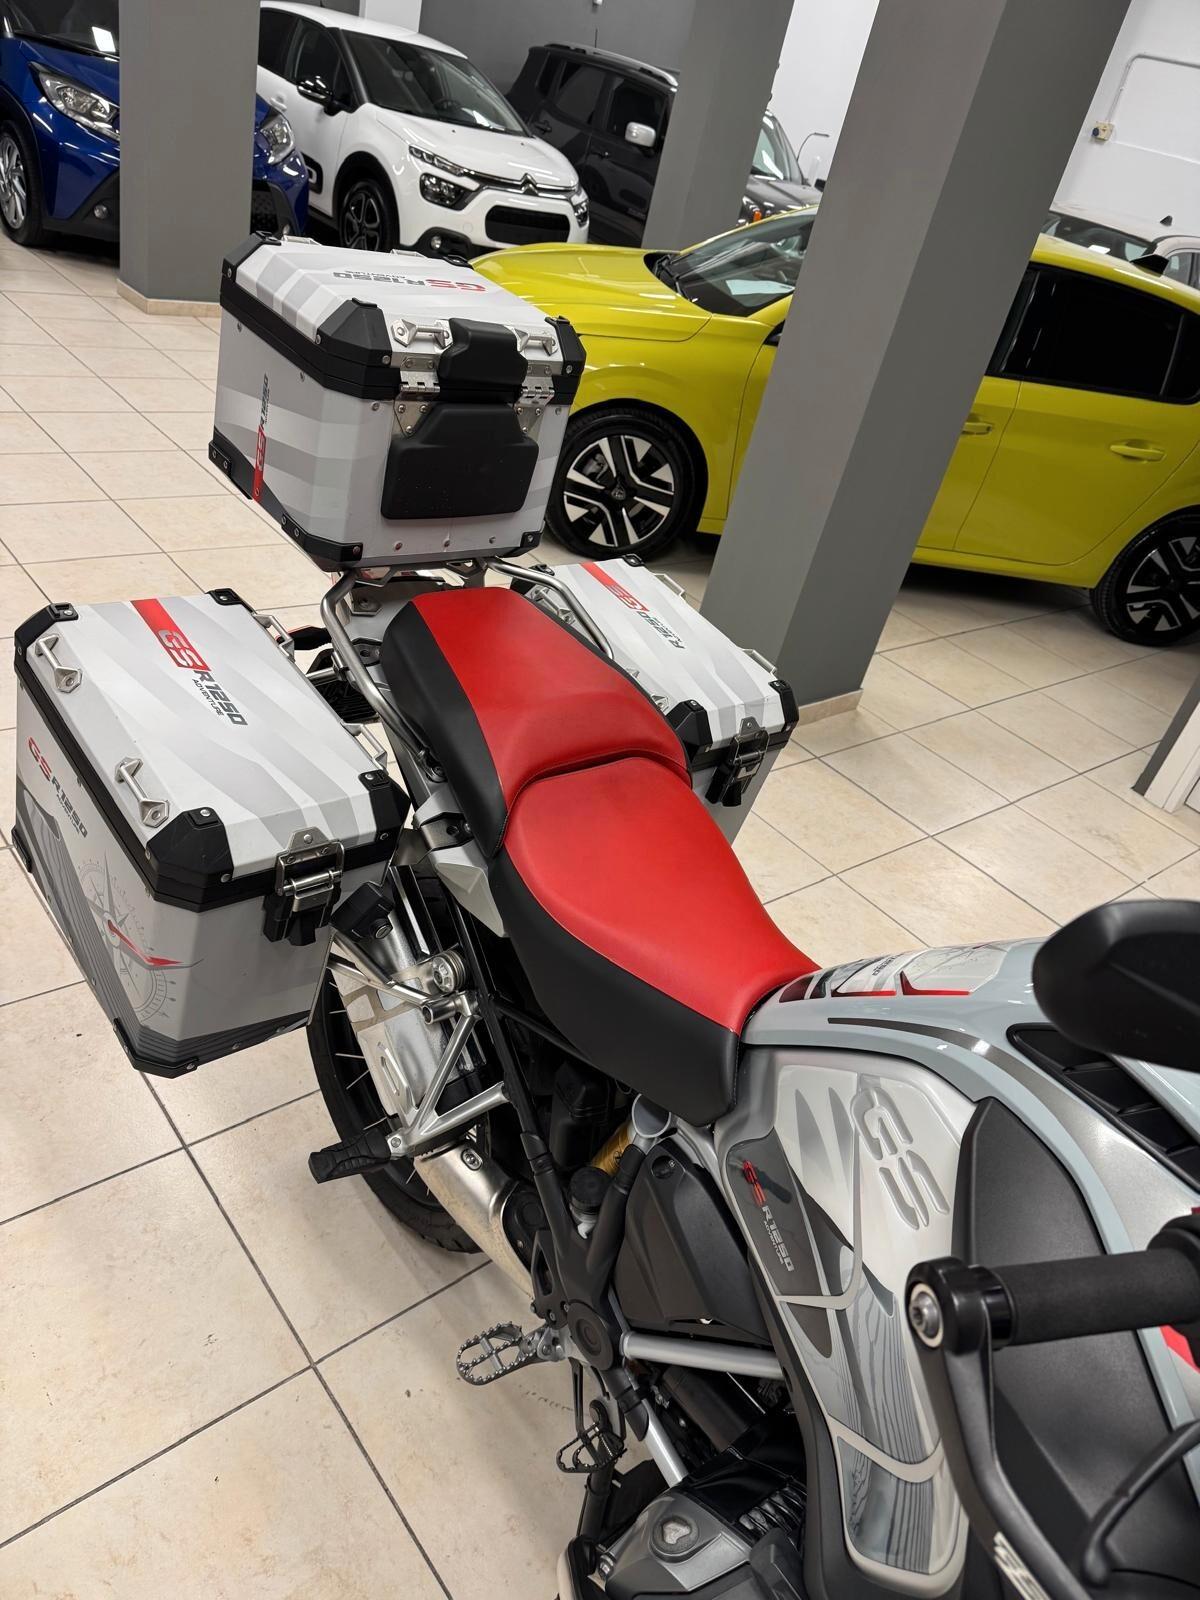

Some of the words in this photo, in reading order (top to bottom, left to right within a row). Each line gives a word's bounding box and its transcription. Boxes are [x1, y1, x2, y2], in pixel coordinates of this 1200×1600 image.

[426, 279, 486, 292] GS
[158, 629, 204, 668] GS
[191, 679, 225, 716] ADVENTURE
[28, 736, 52, 782] GS
[851, 1086, 951, 1231] GS
[742, 1160, 766, 1208] GS
[764, 1220, 785, 1265] ADVENTURE
